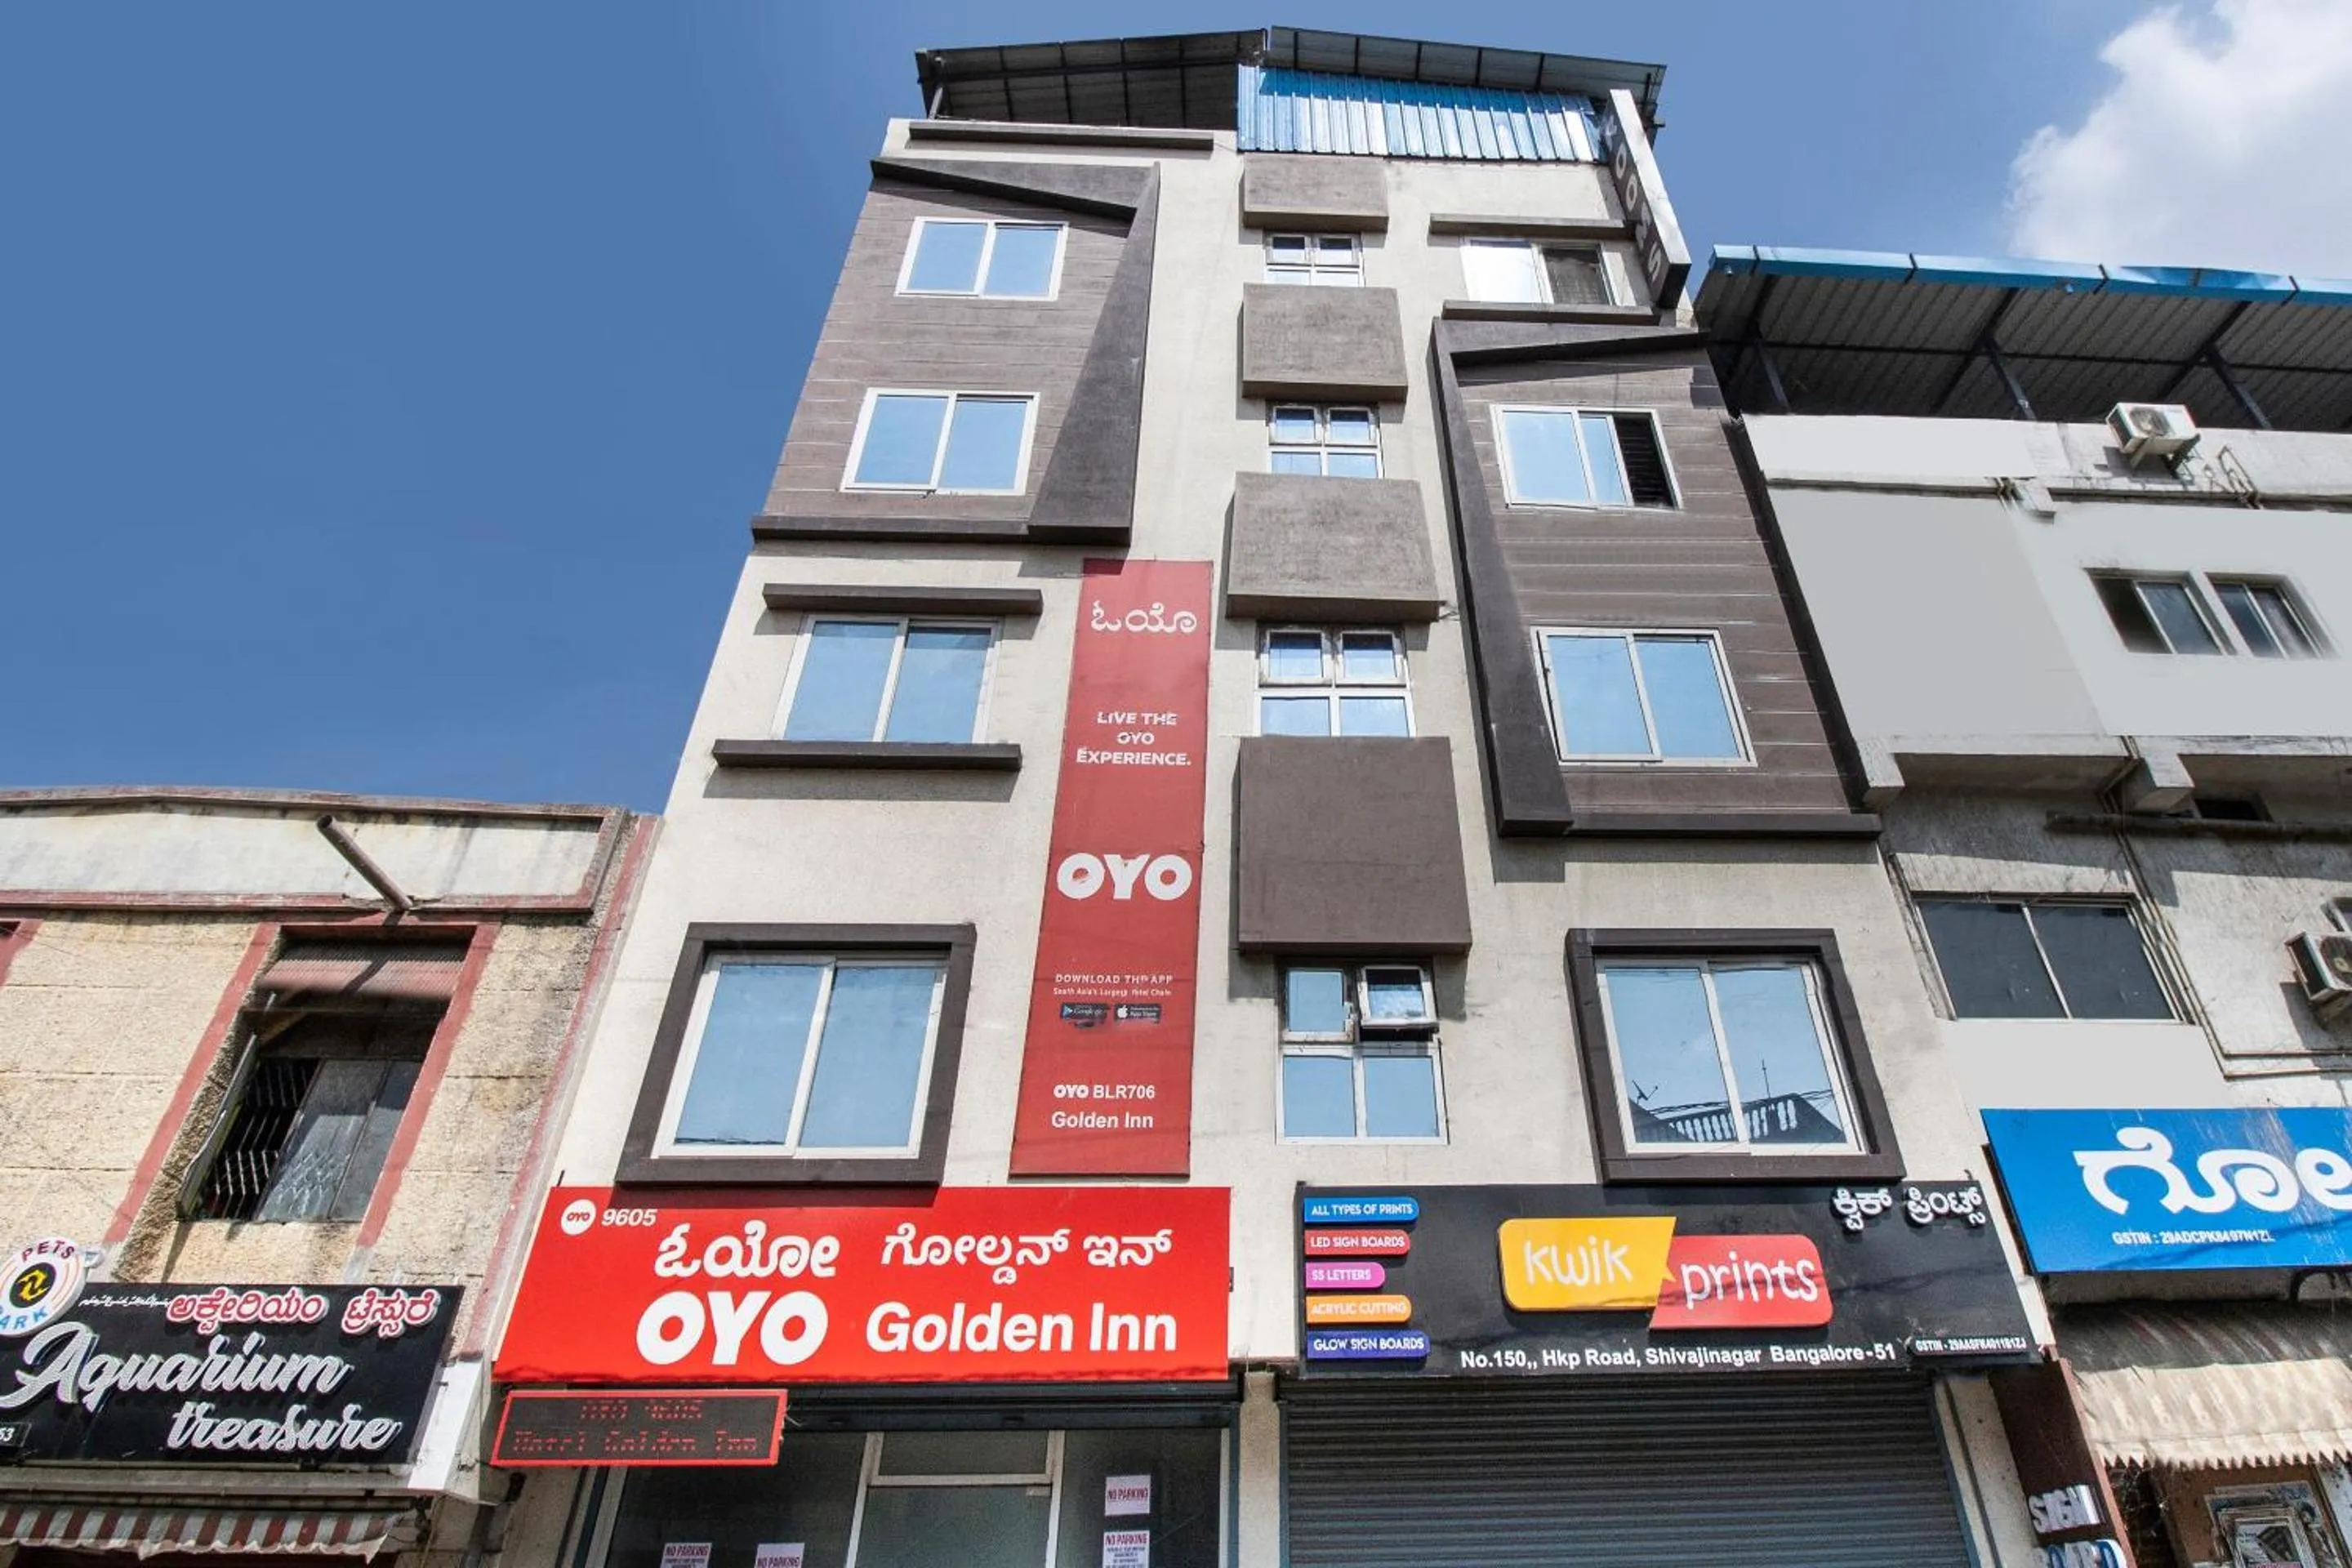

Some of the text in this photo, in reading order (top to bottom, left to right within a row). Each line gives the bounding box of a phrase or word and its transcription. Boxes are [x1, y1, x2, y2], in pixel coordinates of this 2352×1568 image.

[1097, 711, 1178, 726] LIVE THE
[1116, 732, 1155, 745] OYO
[1076, 746, 1192, 766] EXPERIENCE.
[1057, 853, 1192, 901] OYO
[1055, 973, 1120, 984] DOWNLOAD
[1054, 1085, 1156, 1099] OYO BLR706
[1052, 1111, 1154, 1129] Golden Inn
[601, 1209, 658, 1227] 9605
[1312, 1204, 1413, 1216] ALL TYPES OF PRINTS
[1311, 1236, 1405, 1248] LED SIGN BOARDS
[2112, 1231, 2152, 1245] GSTIN
[22, 1240, 75, 1262] PETS
[1327, 1269, 1372, 1281] LETTERS
[1680, 1250, 1820, 1310] prints
[0, 1305, 47, 1330] ARK
[1311, 1303, 1405, 1315] ACRYLIC CUTTING
[637, 1291, 1177, 1365] OYO Golden Inn
[1313, 1338, 1424, 1351] GLOW SIGN BOARDS
[0, 1321, 350, 1412] Aquarium
[1543, 1349, 1581, 1370] Hkp
[1585, 1348, 1641, 1368] Road,
[1646, 1347, 1762, 1368] Shivajinagar
[167, 1400, 400, 1450] treasure
